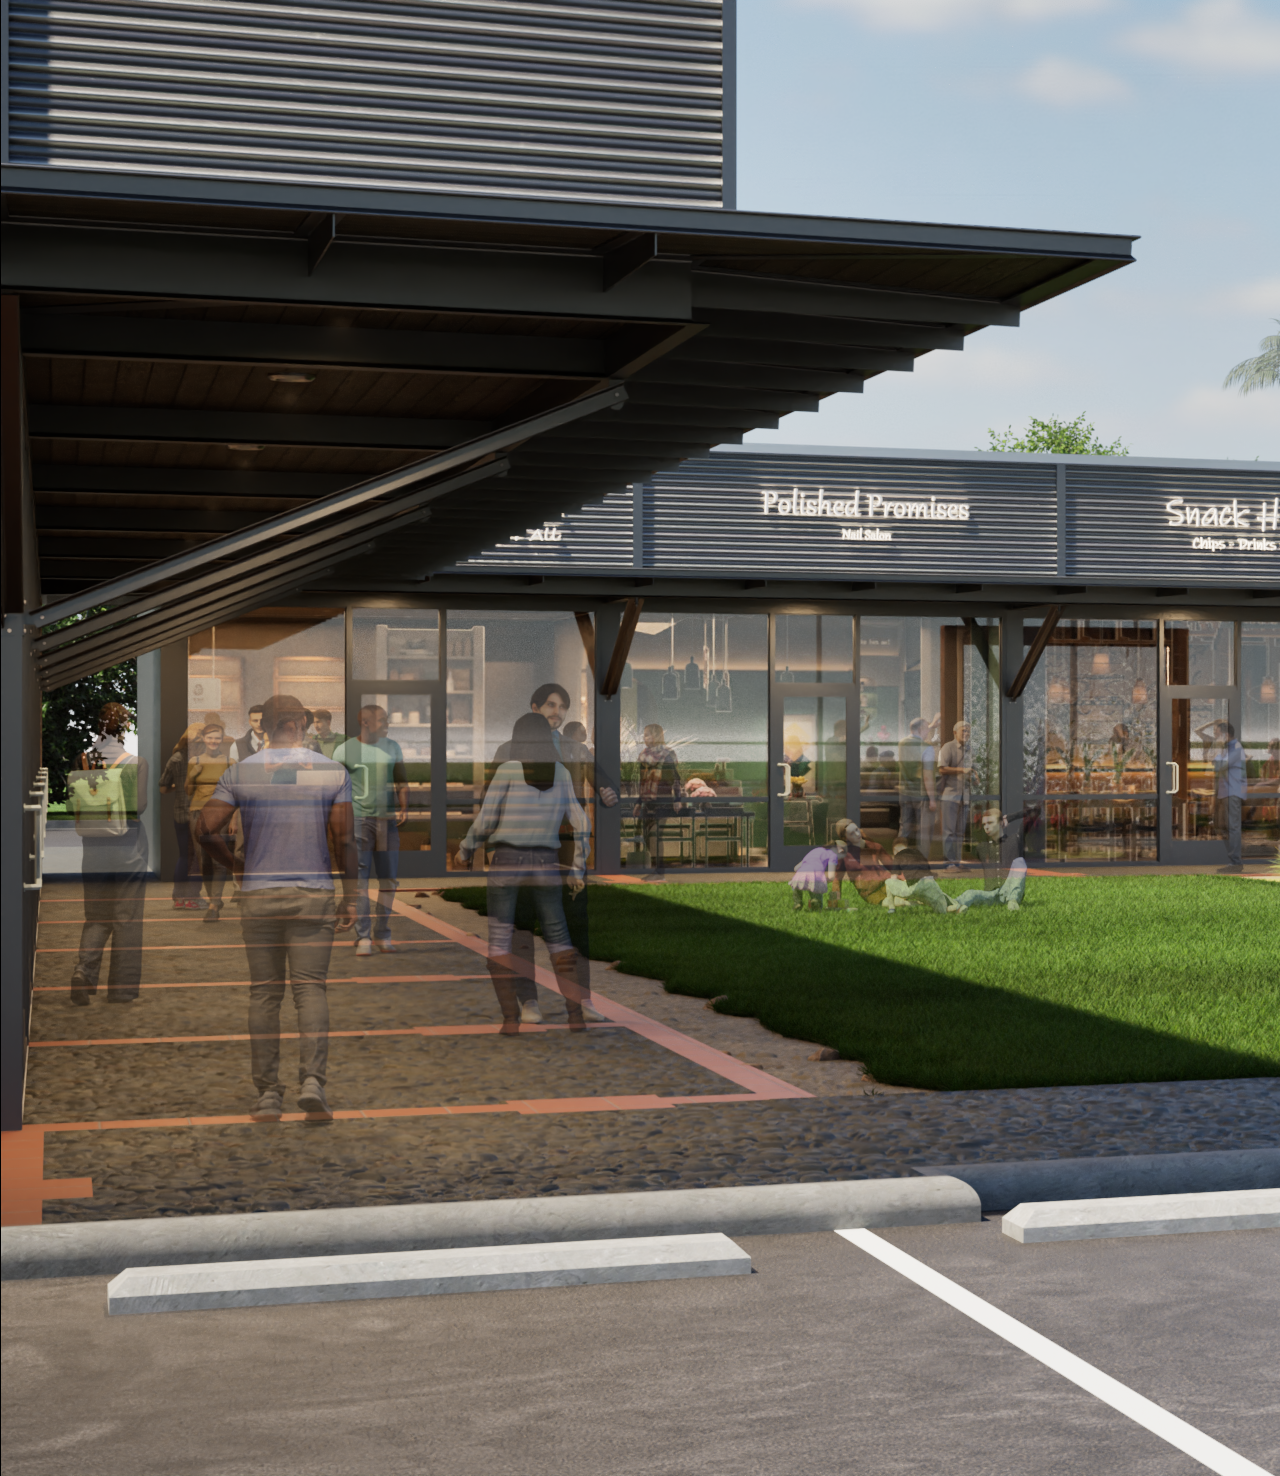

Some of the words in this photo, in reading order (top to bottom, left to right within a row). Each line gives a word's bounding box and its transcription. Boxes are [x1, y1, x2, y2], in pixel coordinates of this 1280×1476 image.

[761, 487, 861, 517] Polished
[866, 493, 971, 520] Promises
[1165, 496, 1250, 528] Snack
[841, 527, 864, 541] Nail
[864, 527, 893, 541] Salon
[1192, 537, 1226, 552] Chips
[1237, 538, 1277, 551] Drinks
